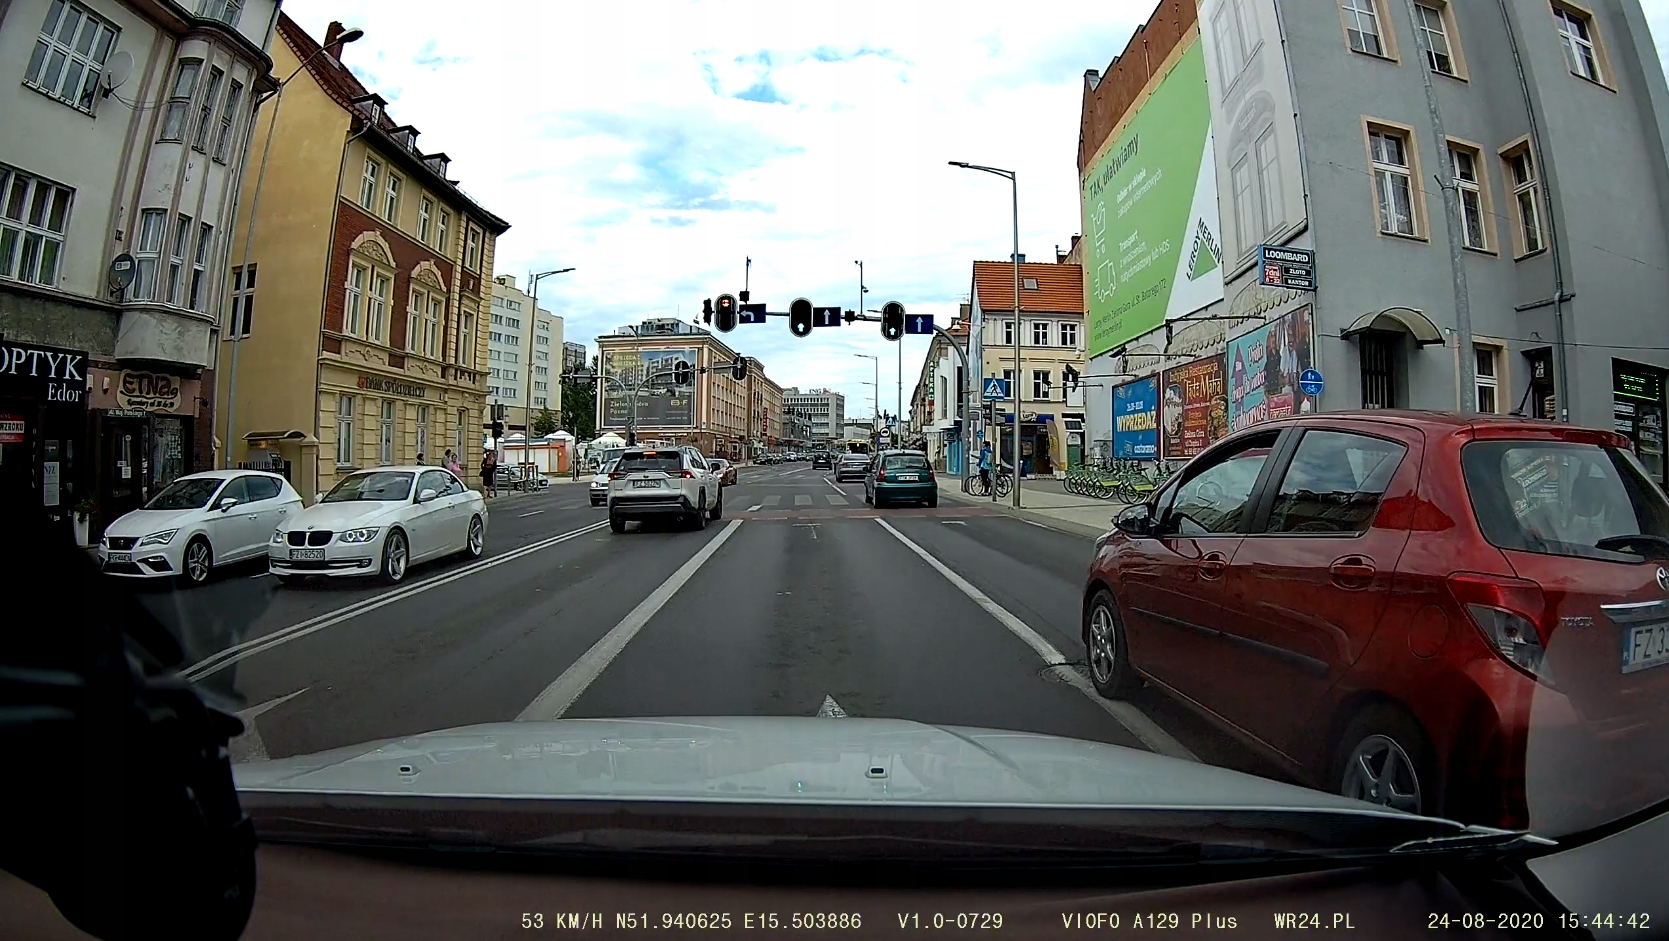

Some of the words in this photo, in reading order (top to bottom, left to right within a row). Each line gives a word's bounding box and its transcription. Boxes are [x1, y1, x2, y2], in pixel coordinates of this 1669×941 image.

[1186, 230, 1201, 281] LEROY
[1198, 217, 1224, 264] MERLIN
[1265, 249, 1309, 262] LOOMBARD
[47, 382, 82, 402] Edor
[1200, 370, 1223, 402] Mahal
[1116, 405, 1157, 432] WYPRZEDAŻ
[1632, 627, 1655, 661] FZ
